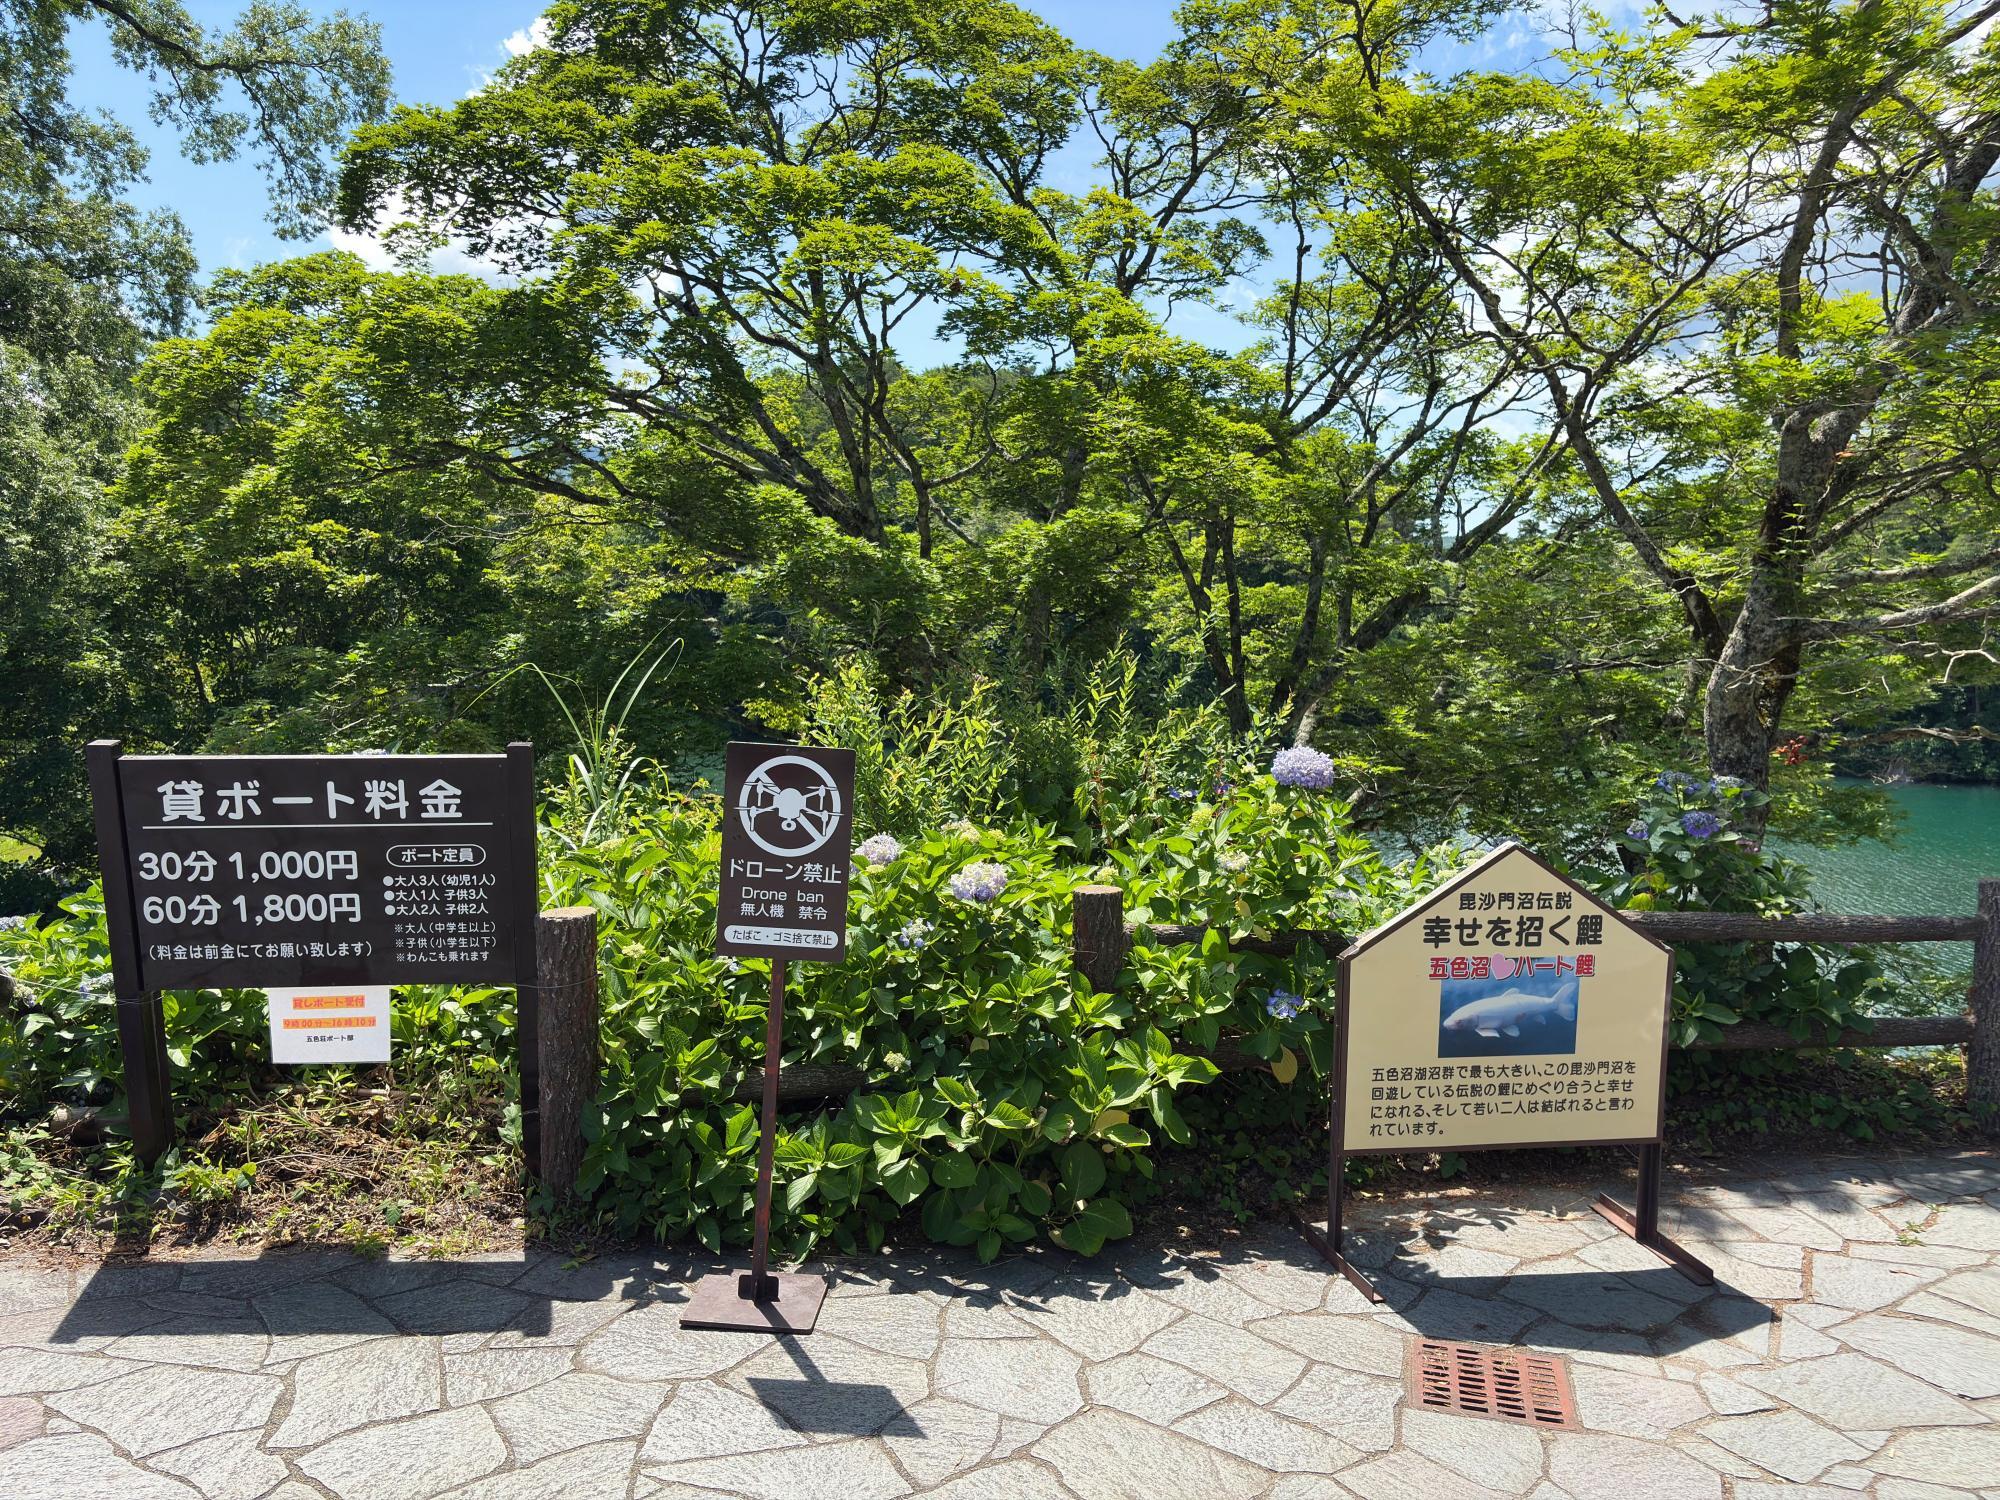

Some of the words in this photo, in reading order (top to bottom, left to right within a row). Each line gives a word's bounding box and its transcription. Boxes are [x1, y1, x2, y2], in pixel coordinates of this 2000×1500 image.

[156, 778, 463, 822] 貸ボート料金
[401, 847, 474, 863] ボート定員
[138, 850, 217, 882] 30分
[228, 850, 359, 883] 1,000円
[729, 858, 842, 884] ドローン禁止
[444, 887, 488, 900] 子供3人
[741, 886, 788, 901] Drone
[797, 890, 824, 904] ban
[1458, 891, 1572, 911] 毘沙門沼伝説
[143, 894, 222, 926] 60分
[232, 893, 362, 926] 1,800円
[445, 902, 489, 915] 子供2人
[740, 902, 785, 918] 無人機
[798, 906, 828, 921] 禁令
[732, 929, 833, 946] たばこ・ゴミ捨て禁止
[1423, 914, 1603, 949] 幸せを招く鯉
[1371, 1060, 1637, 1082] 五色沼湖沼群で最も大きい、この毘沙門沼を
[1371, 1079, 1634, 1101] 回遊している伝説の鯉にめぐり合うと幸せ
[1369, 1120, 1445, 1137] れています。
